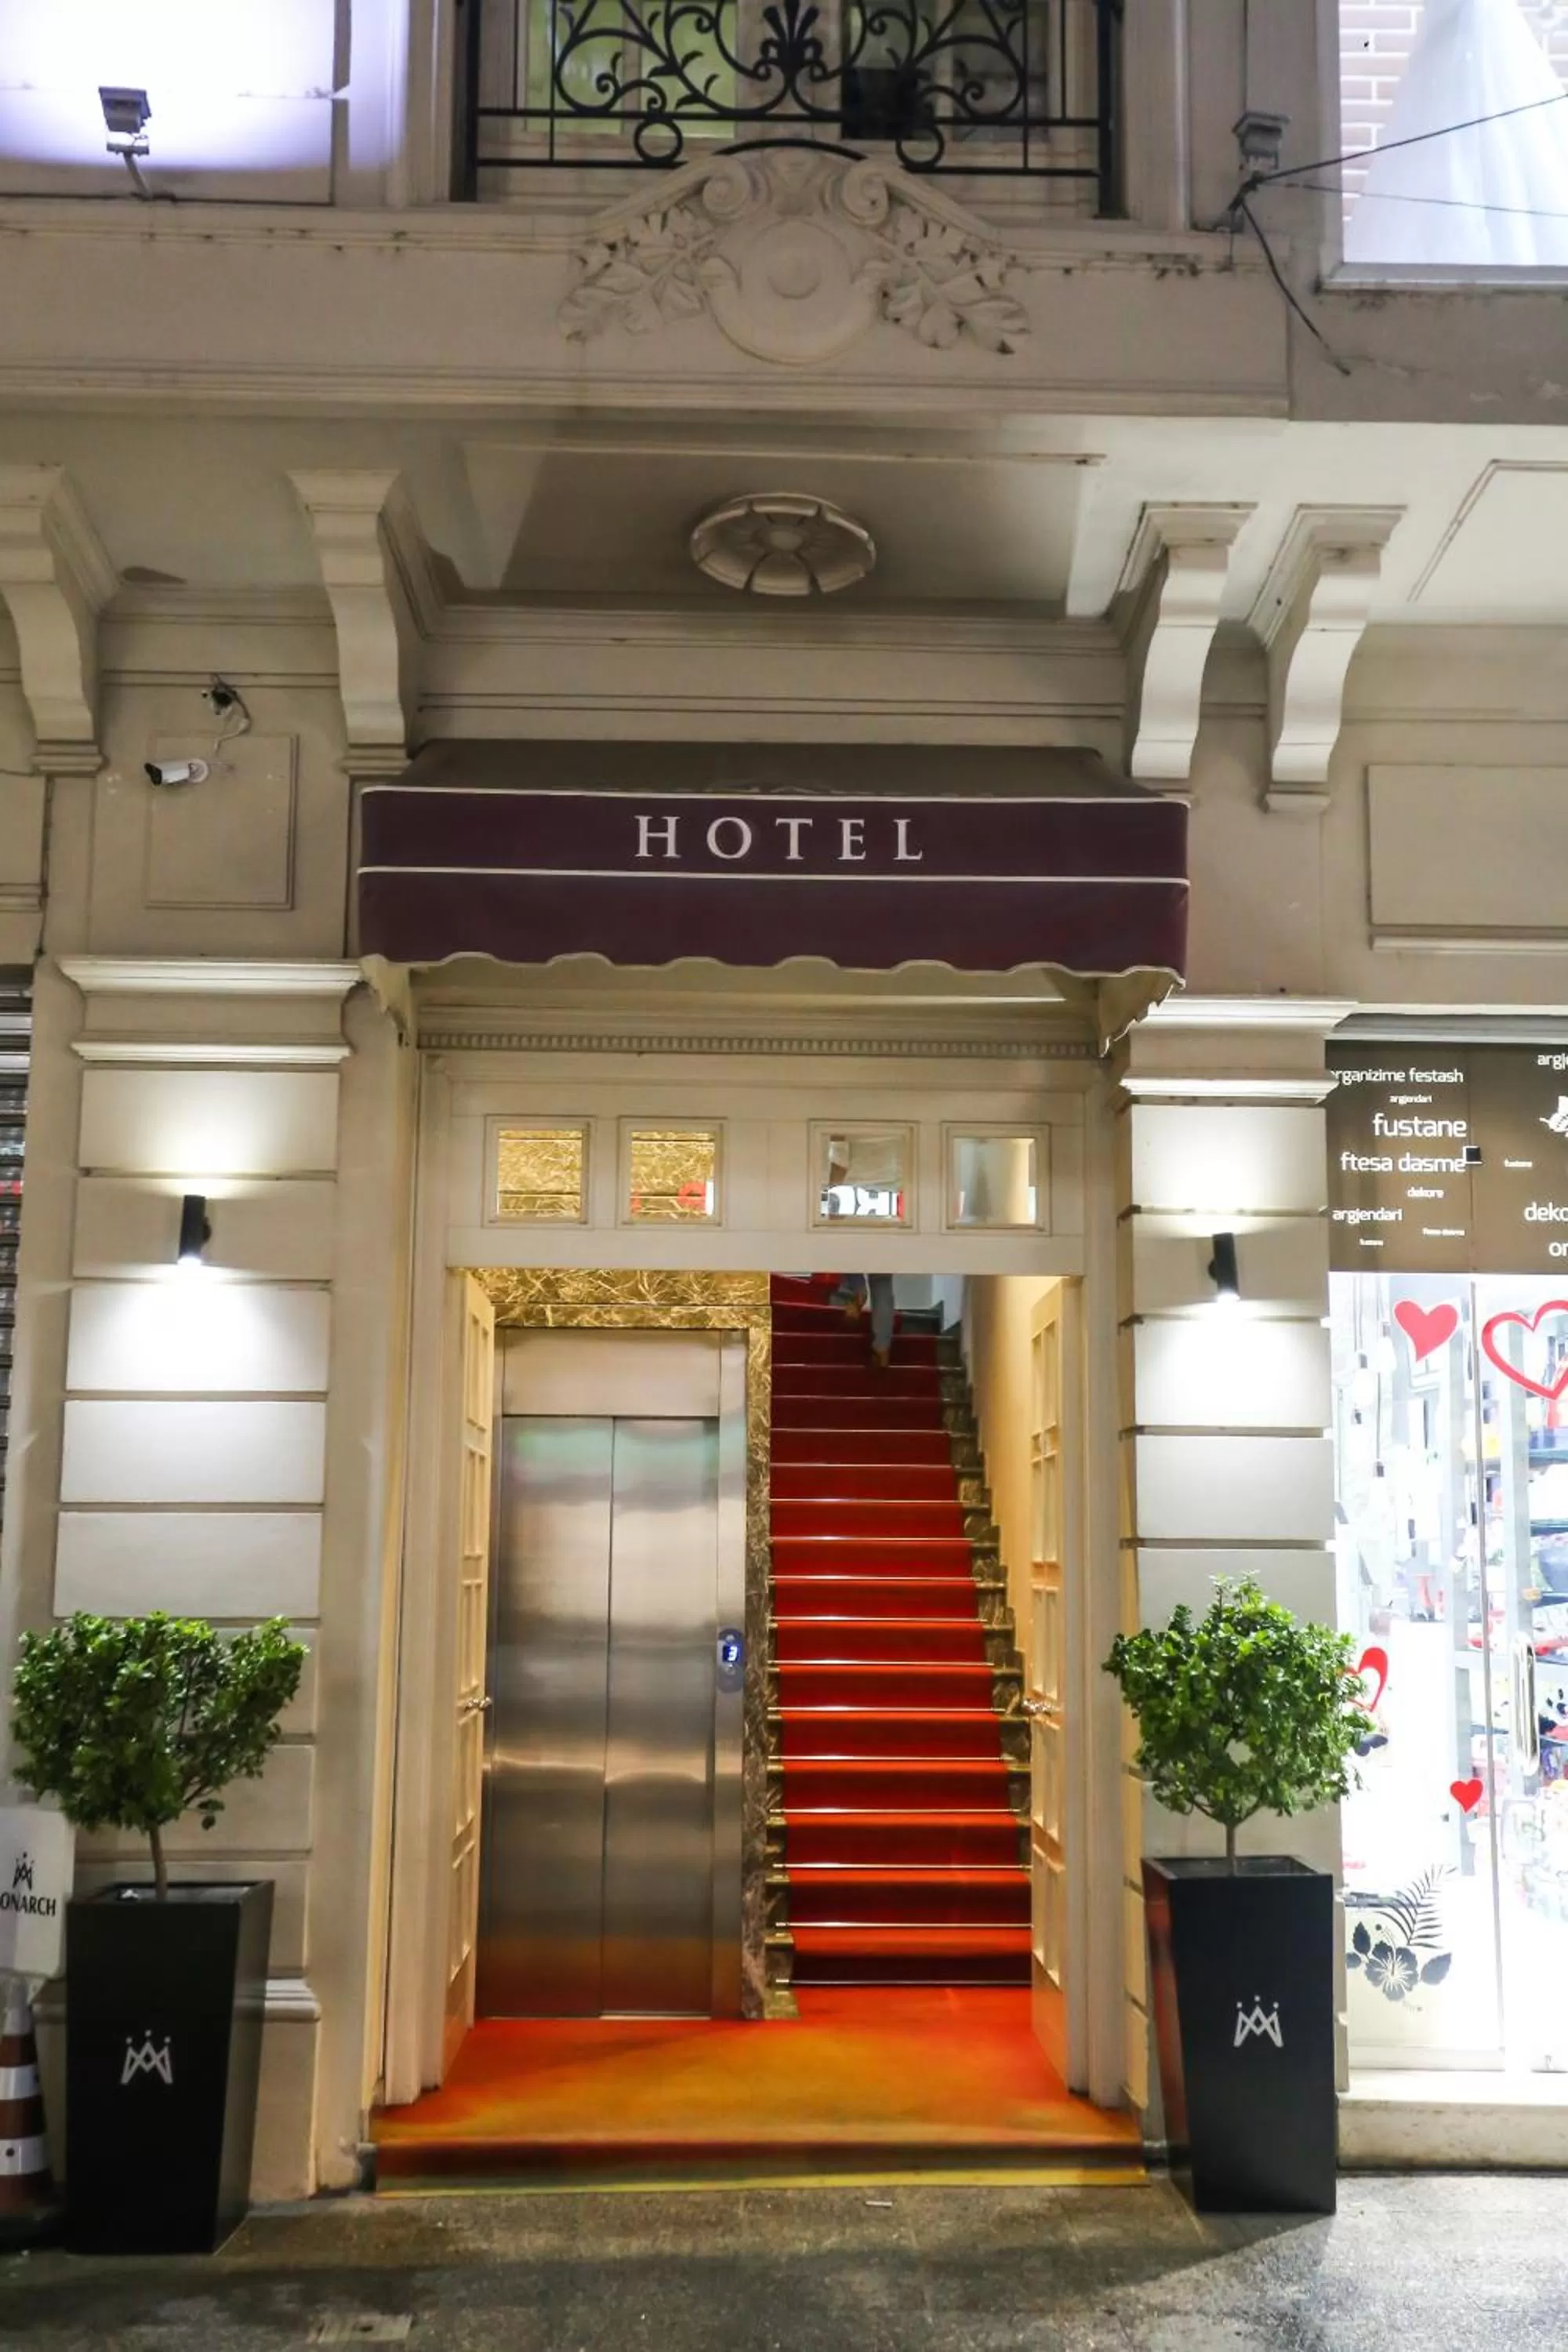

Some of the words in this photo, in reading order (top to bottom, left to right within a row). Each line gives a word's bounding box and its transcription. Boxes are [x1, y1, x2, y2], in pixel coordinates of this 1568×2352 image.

[634, 815, 924, 861] HOTEL
[1537, 1053, 1568, 1070] argj
[1409, 1067, 1464, 1083] festash
[1373, 1112, 1467, 1138] fustane
[1340, 1152, 1393, 1172] ftesa
[1398, 1152, 1465, 1173] dasme
[1332, 1206, 1403, 1224] argjendari
[0, 1891, 56, 1917] ONARCH
